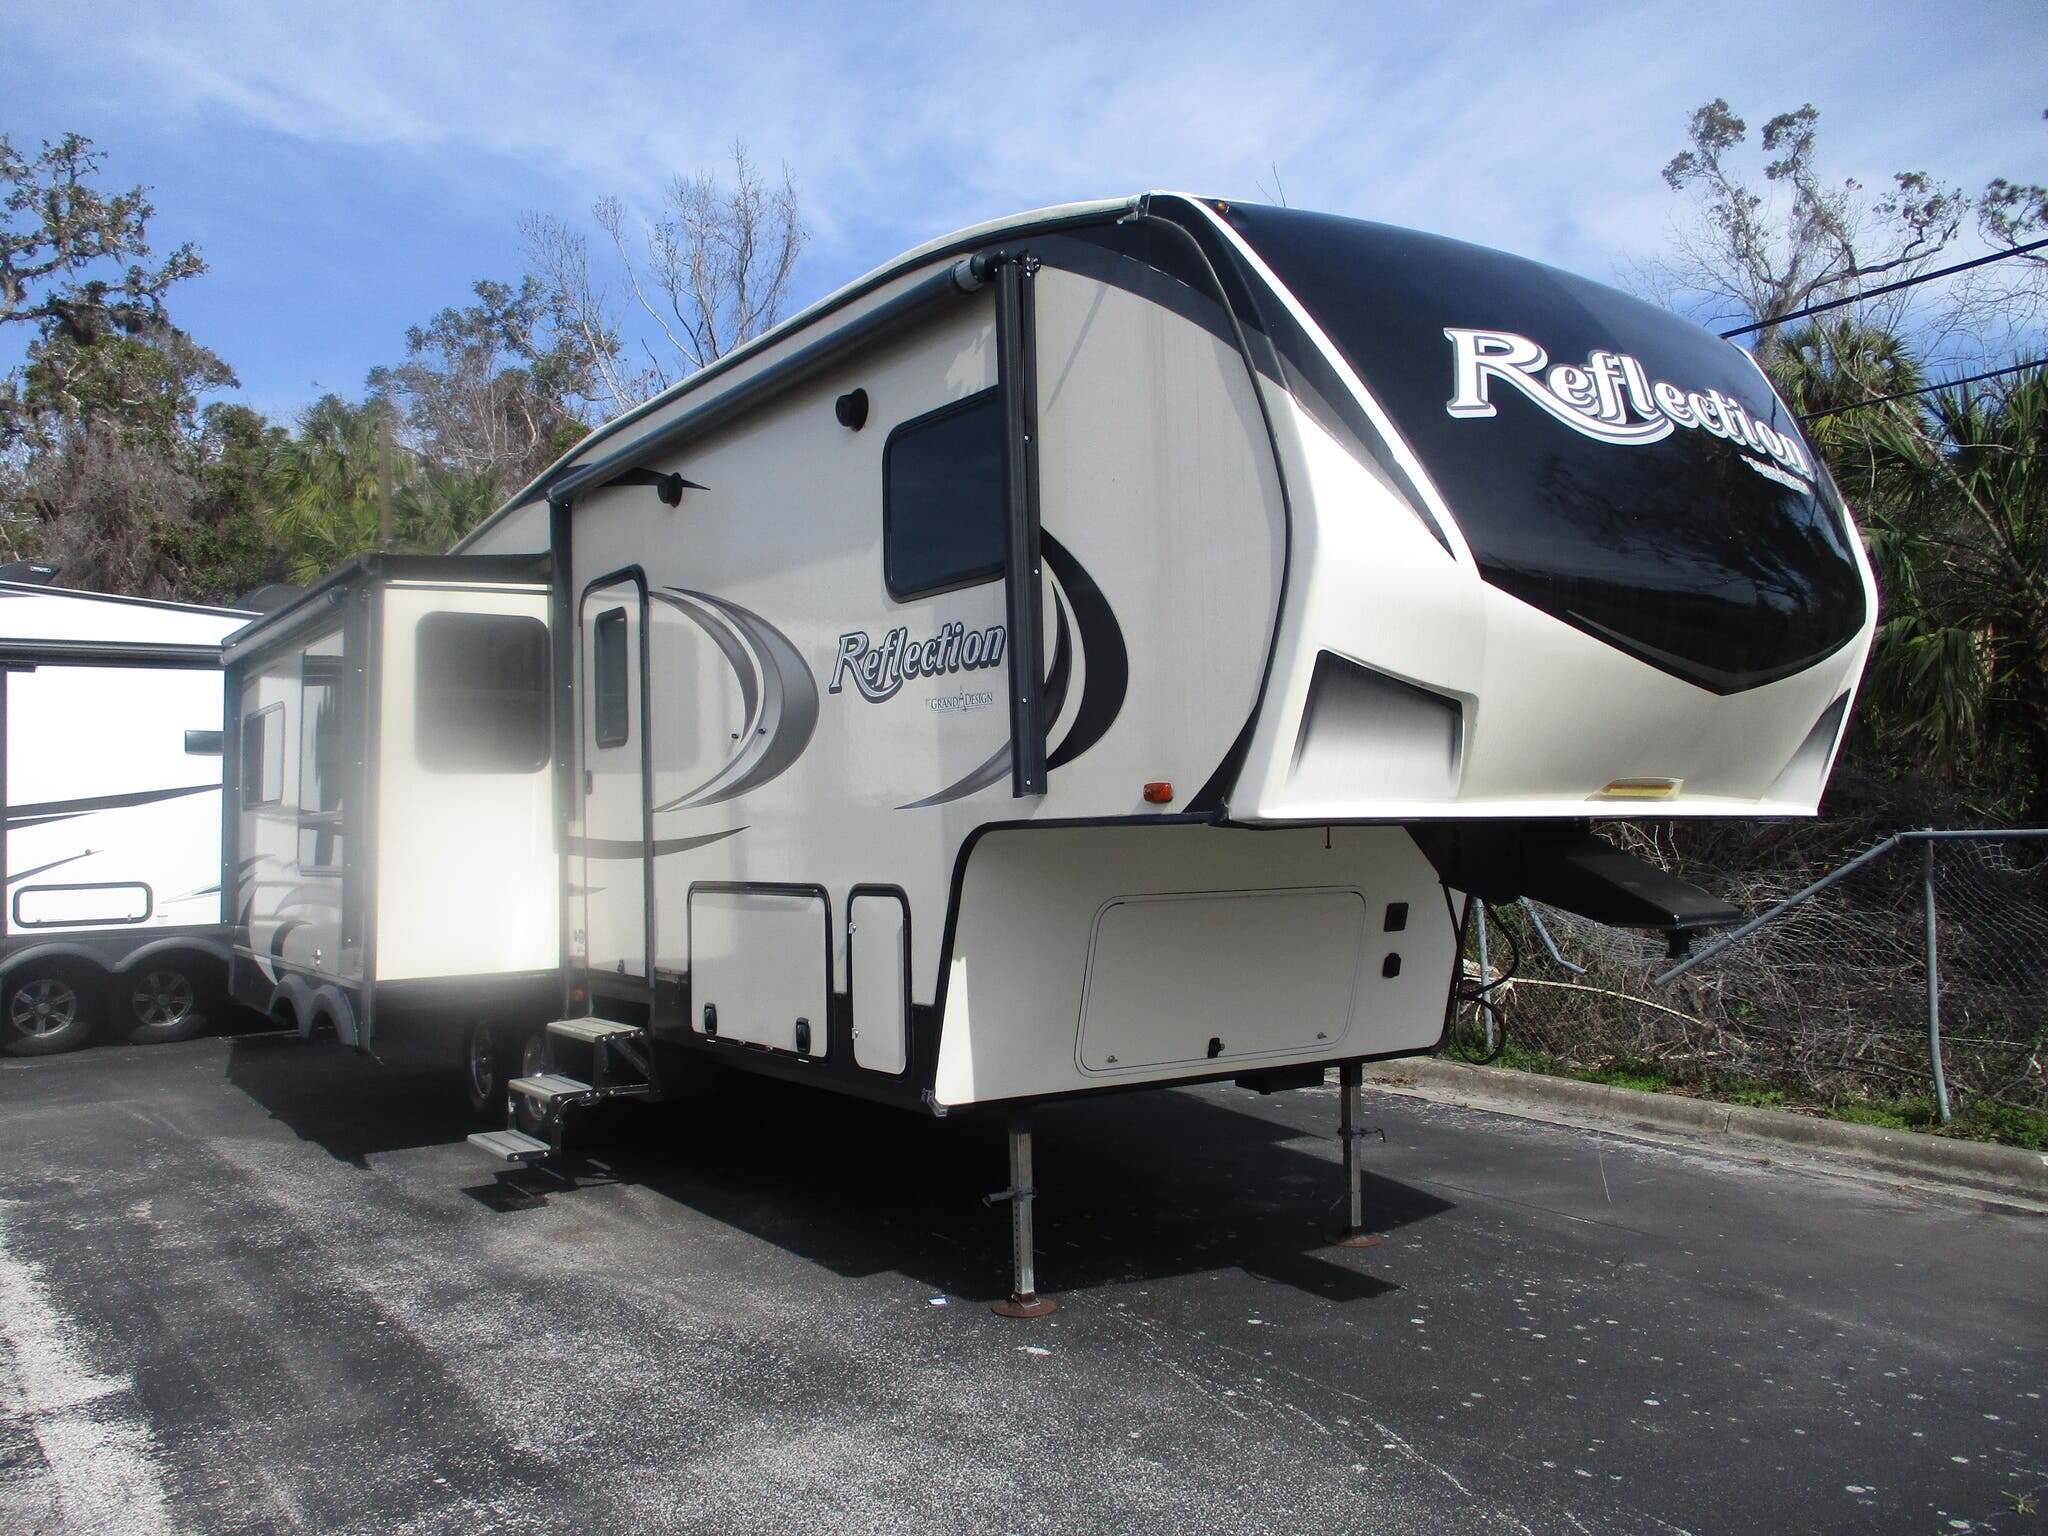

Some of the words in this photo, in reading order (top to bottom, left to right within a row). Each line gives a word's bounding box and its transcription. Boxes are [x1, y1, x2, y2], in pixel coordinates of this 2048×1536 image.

[1443, 327, 1816, 482] Reflection
[828, 621, 1007, 704] Reflection
[930, 696, 960, 710] GRAND
[964, 692, 993, 706] DESIGN
